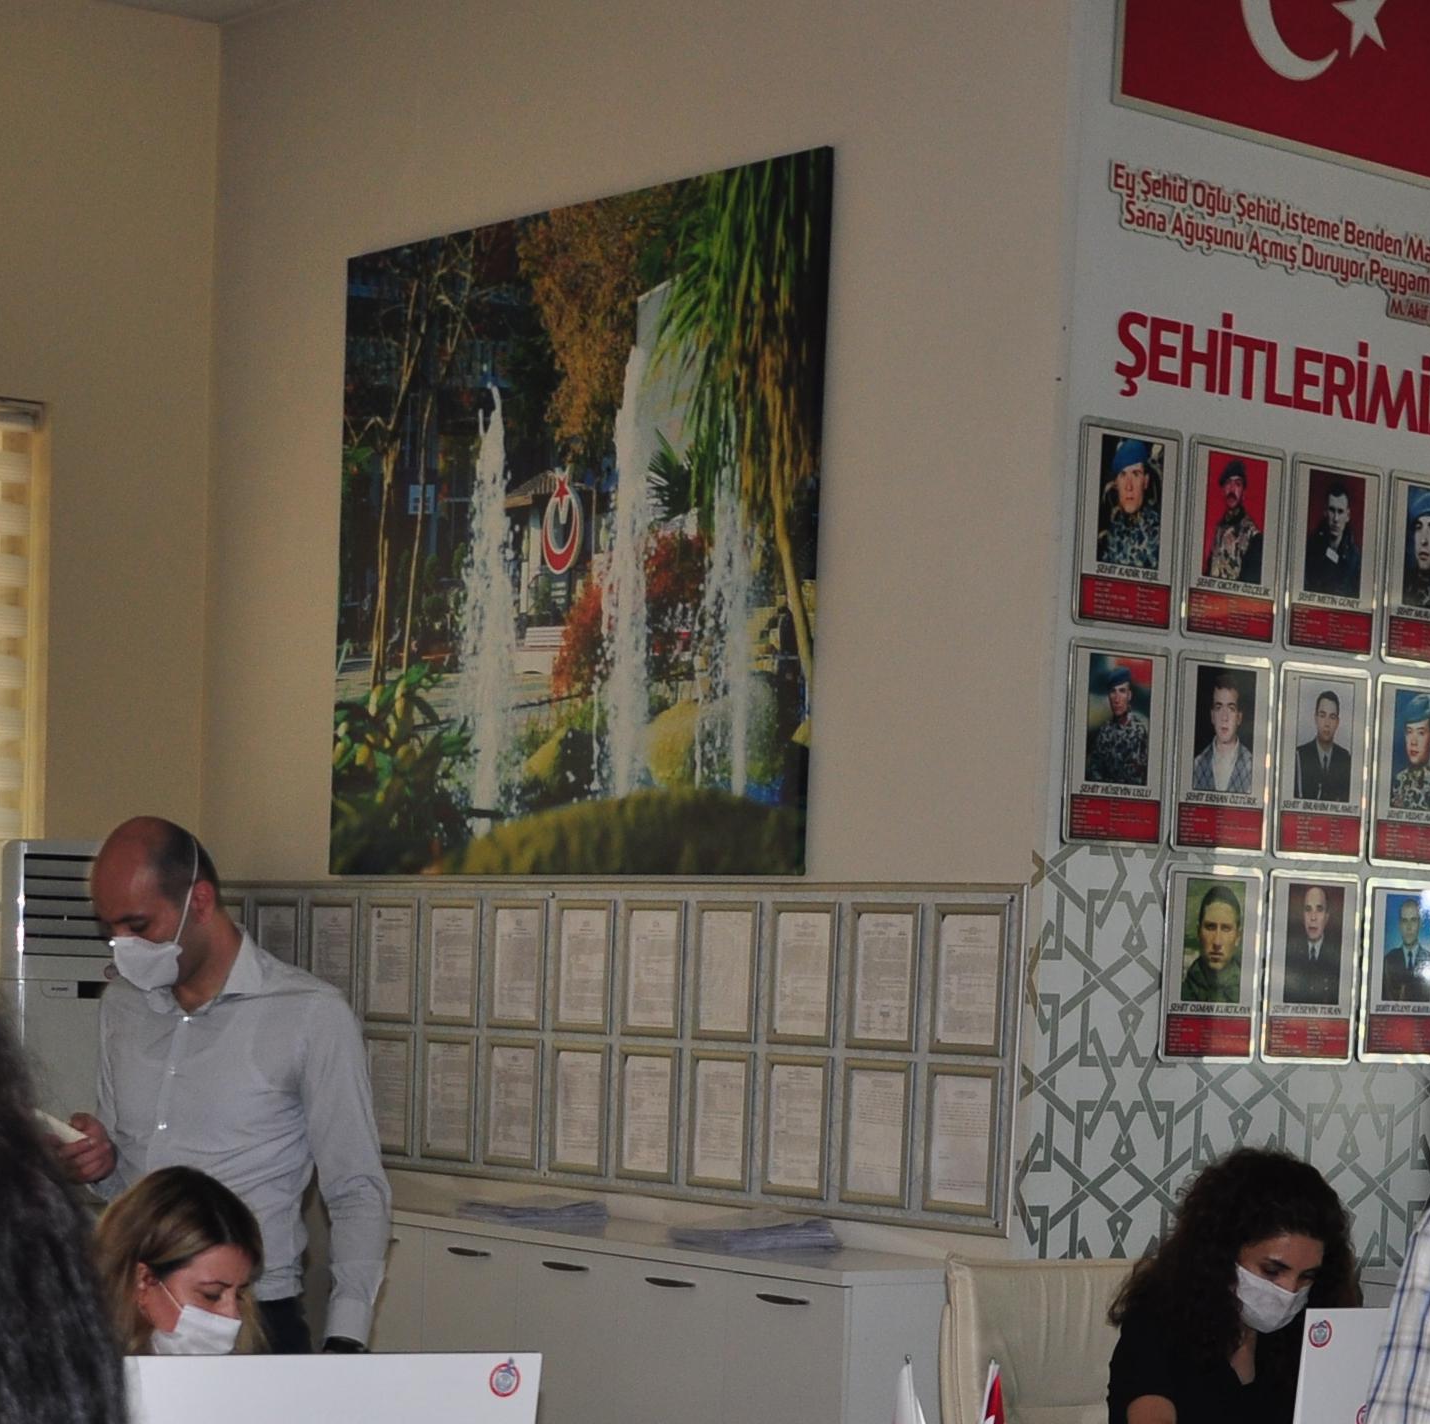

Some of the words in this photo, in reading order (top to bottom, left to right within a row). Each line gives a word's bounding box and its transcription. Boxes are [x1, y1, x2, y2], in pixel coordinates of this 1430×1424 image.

[1113, 163, 1136, 199] Ey
[1140, 169, 1188, 204] Şehid
[1192, 183, 1231, 218] Oğlu
[1344, 220, 1403, 257] Benden
[1124, 200, 1167, 233] Sana
[1171, 212, 1244, 251] Ağuşunu
[1248, 230, 1297, 270] Açmış
[1302, 243, 1366, 282] Duruyor
[1407, 302, 1429, 321] Akif
